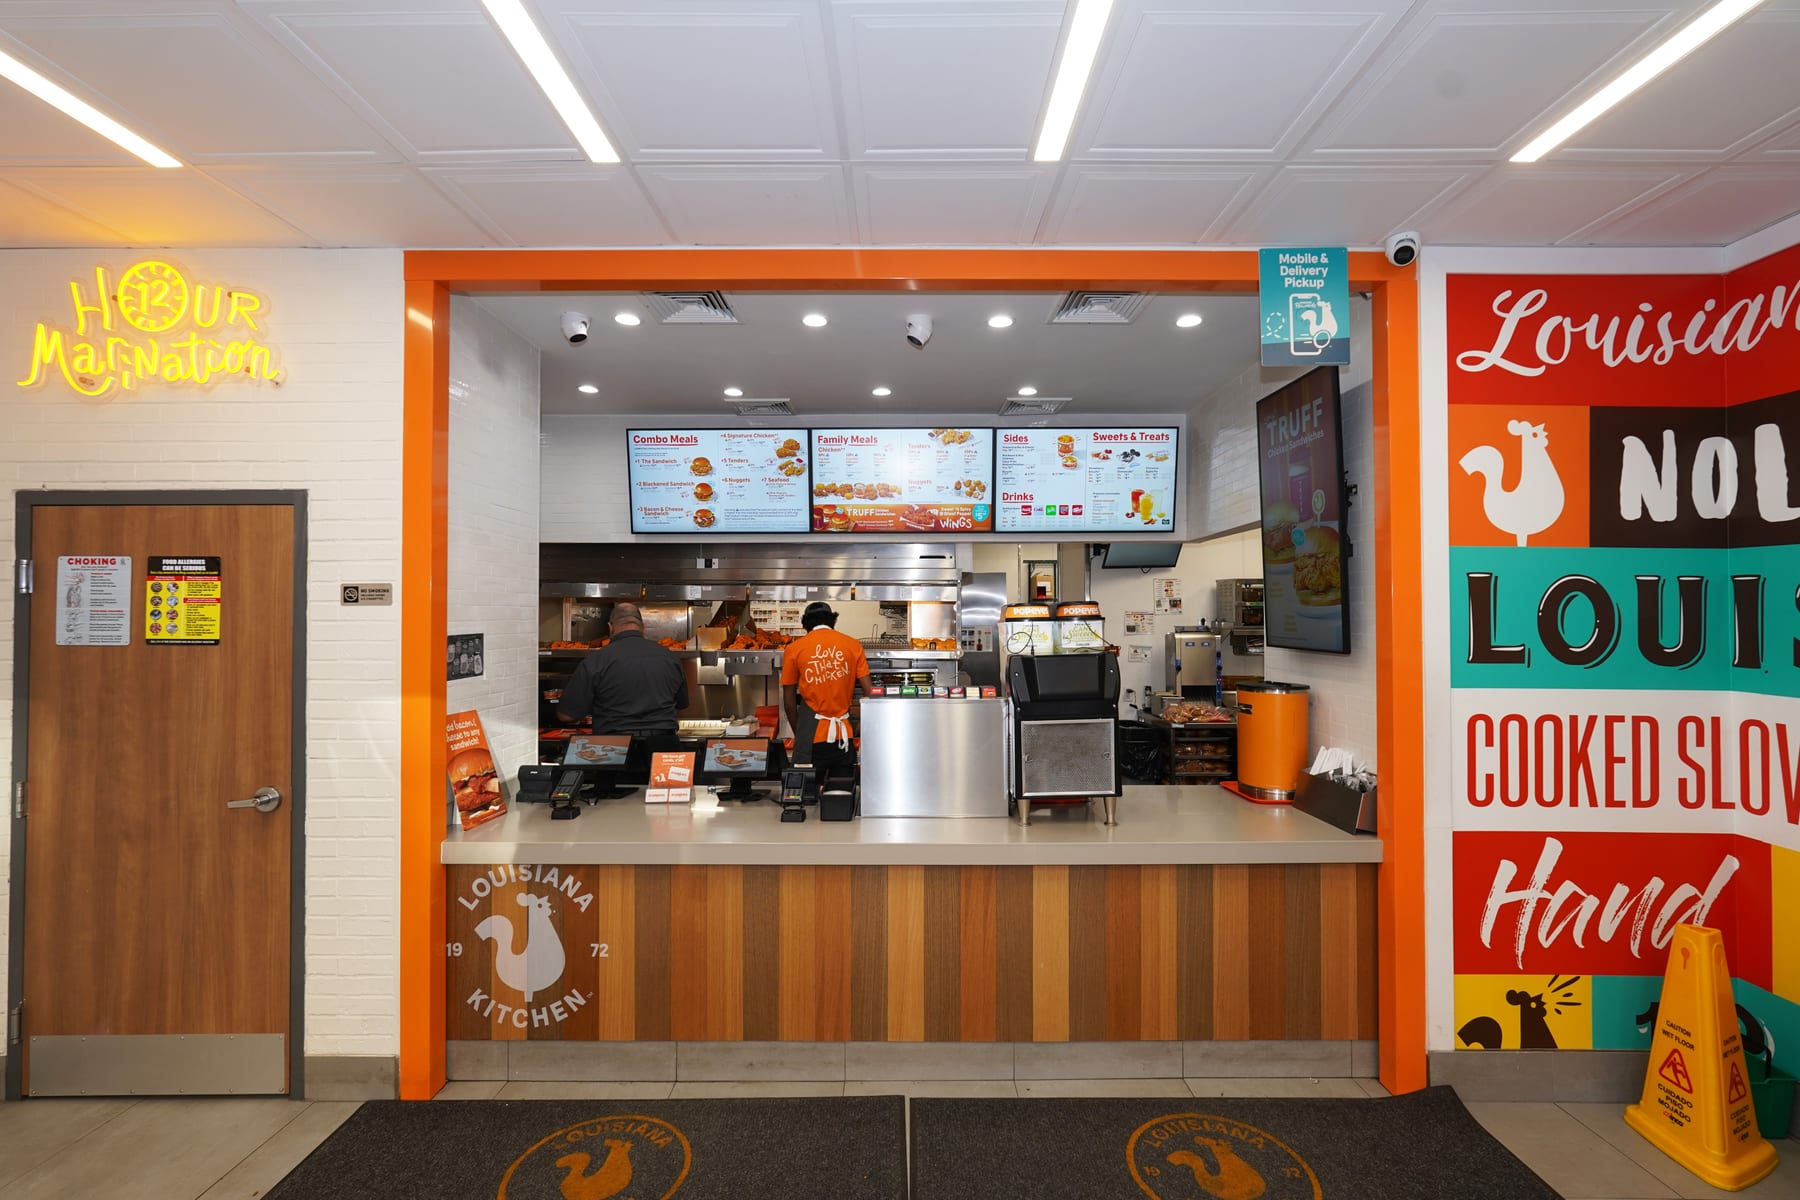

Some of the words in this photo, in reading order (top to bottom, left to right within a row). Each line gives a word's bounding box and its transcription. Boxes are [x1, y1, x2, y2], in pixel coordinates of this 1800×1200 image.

[1279, 253, 1318, 264] Mobile
[1320, 253, 1329, 264] &
[1280, 265, 1329, 278] Delivery
[1284, 277, 1324, 290] Pickup
[1267, 397, 1323, 447] TRUFF
[633, 435, 668, 444] Combo
[670, 435, 698, 444] Meals
[817, 435, 848, 445] Family
[850, 435, 878, 444] Meals
[1003, 434, 1029, 443] Sides
[1093, 432, 1128, 441] Sweets
[1130, 432, 1137, 441] &
[1139, 432, 1170, 441] Treats
[1002, 492, 1034, 501] Drinks
[846, 507, 875, 516] TRUFF
[1466, 571, 1800, 670] LOUI
[1467, 714, 1659, 809] COOKED
[457, 864, 594, 913] LOUISIANA
[1480, 837, 1740, 970] Hand
[446, 943, 463, 957] 19
[590, 943, 609, 958] 72
[466, 988, 587, 1029] KITCHEN
[1666, 1020, 1692, 1038] CAUTION
[1662, 1028, 1674, 1040] WET
[1674, 1035, 1695, 1051] FLOOR
[1657, 1083, 1693, 1109] CUIDADO
[1665, 1095, 1684, 1111] PISO
[1657, 1097, 1692, 1123] MOJADO
[550, 1121, 673, 1151] LOUISIANA
[1143, 1119, 1266, 1151] LOUISIANA
